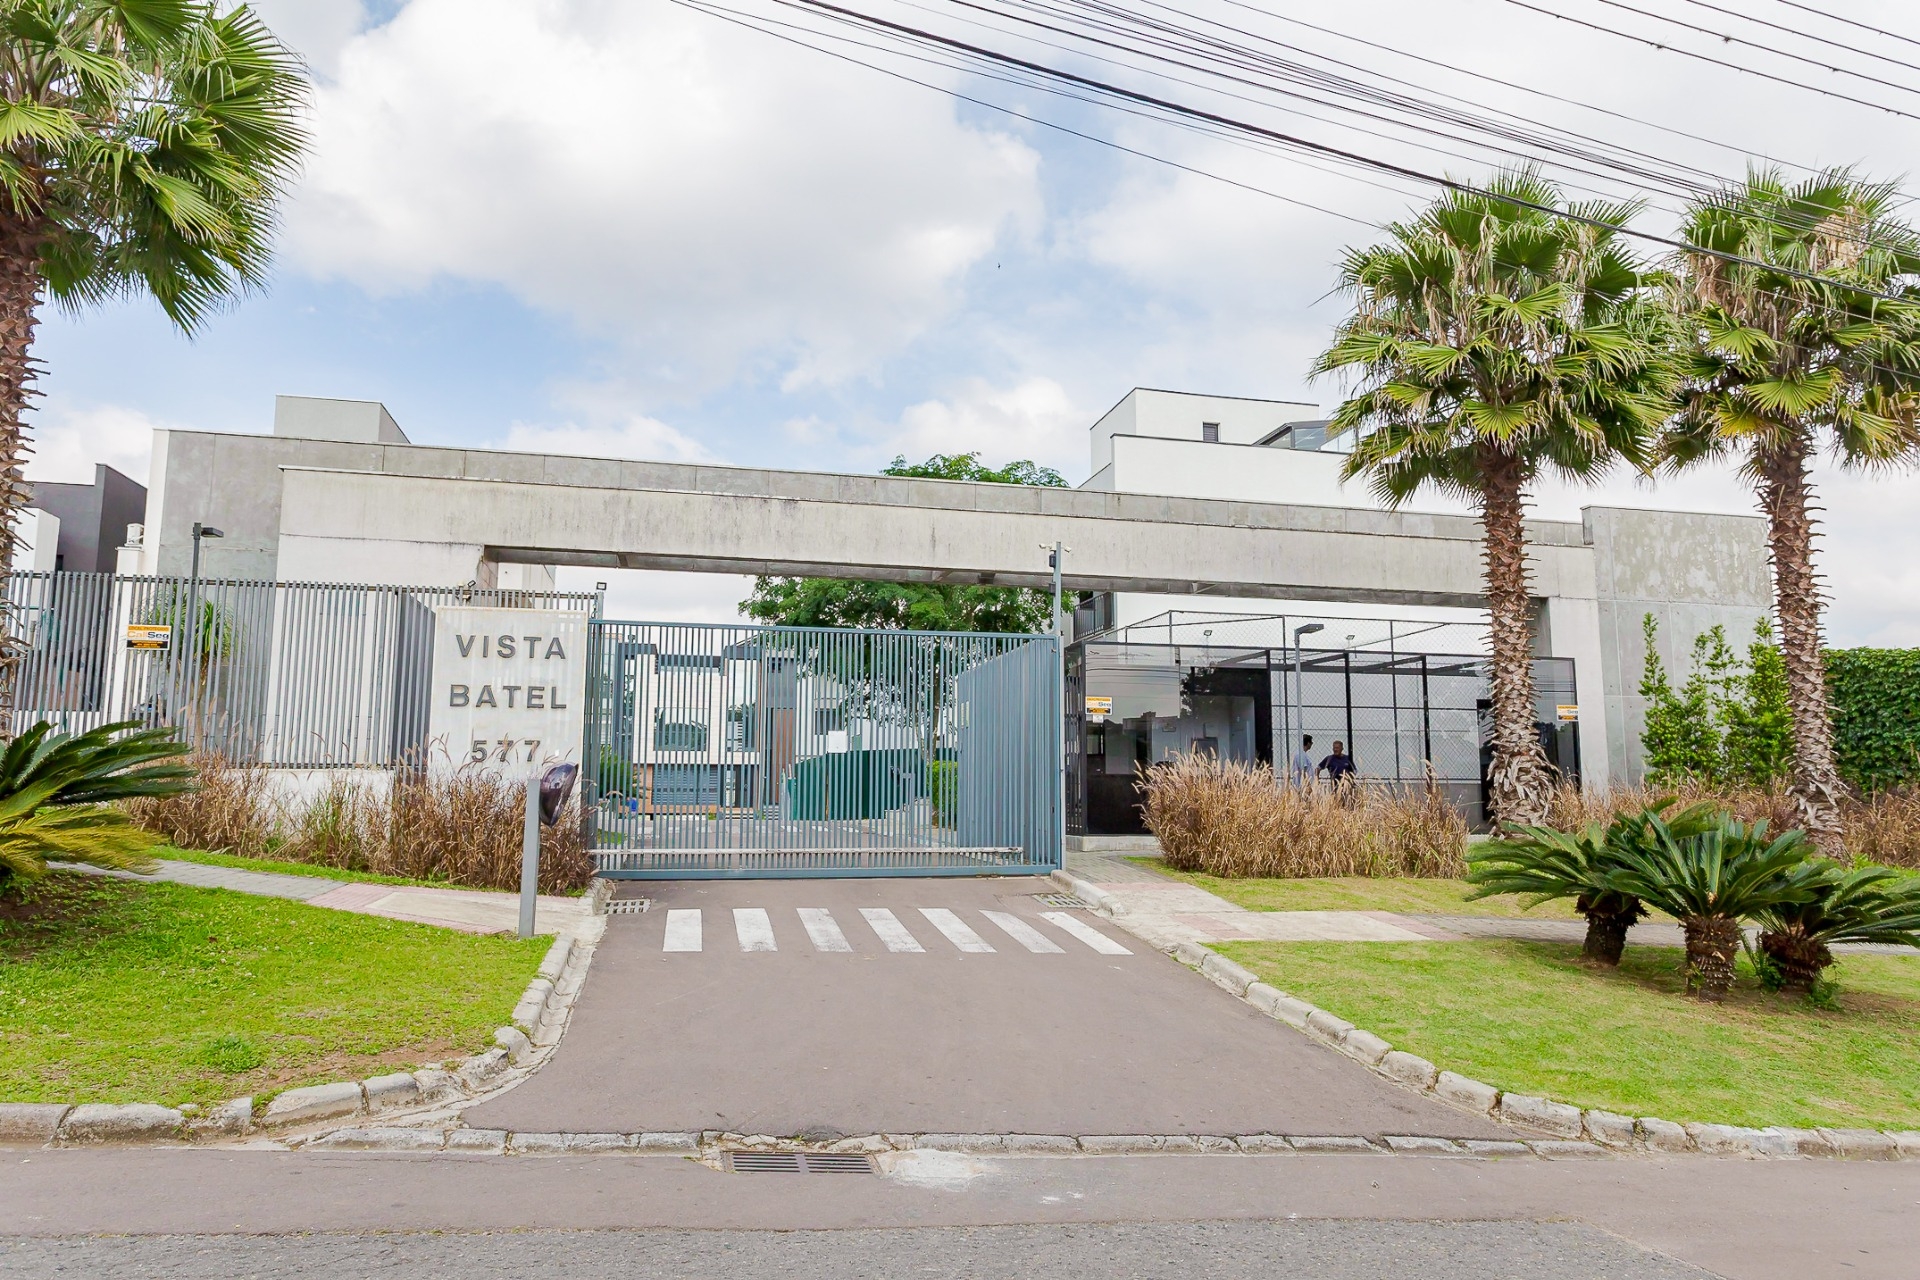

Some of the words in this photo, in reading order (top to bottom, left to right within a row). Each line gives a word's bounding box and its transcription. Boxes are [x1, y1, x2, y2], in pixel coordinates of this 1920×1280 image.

[455, 634, 566, 660] VISTA
[449, 683, 567, 709] BATEL
[471, 739, 541, 763] 577
